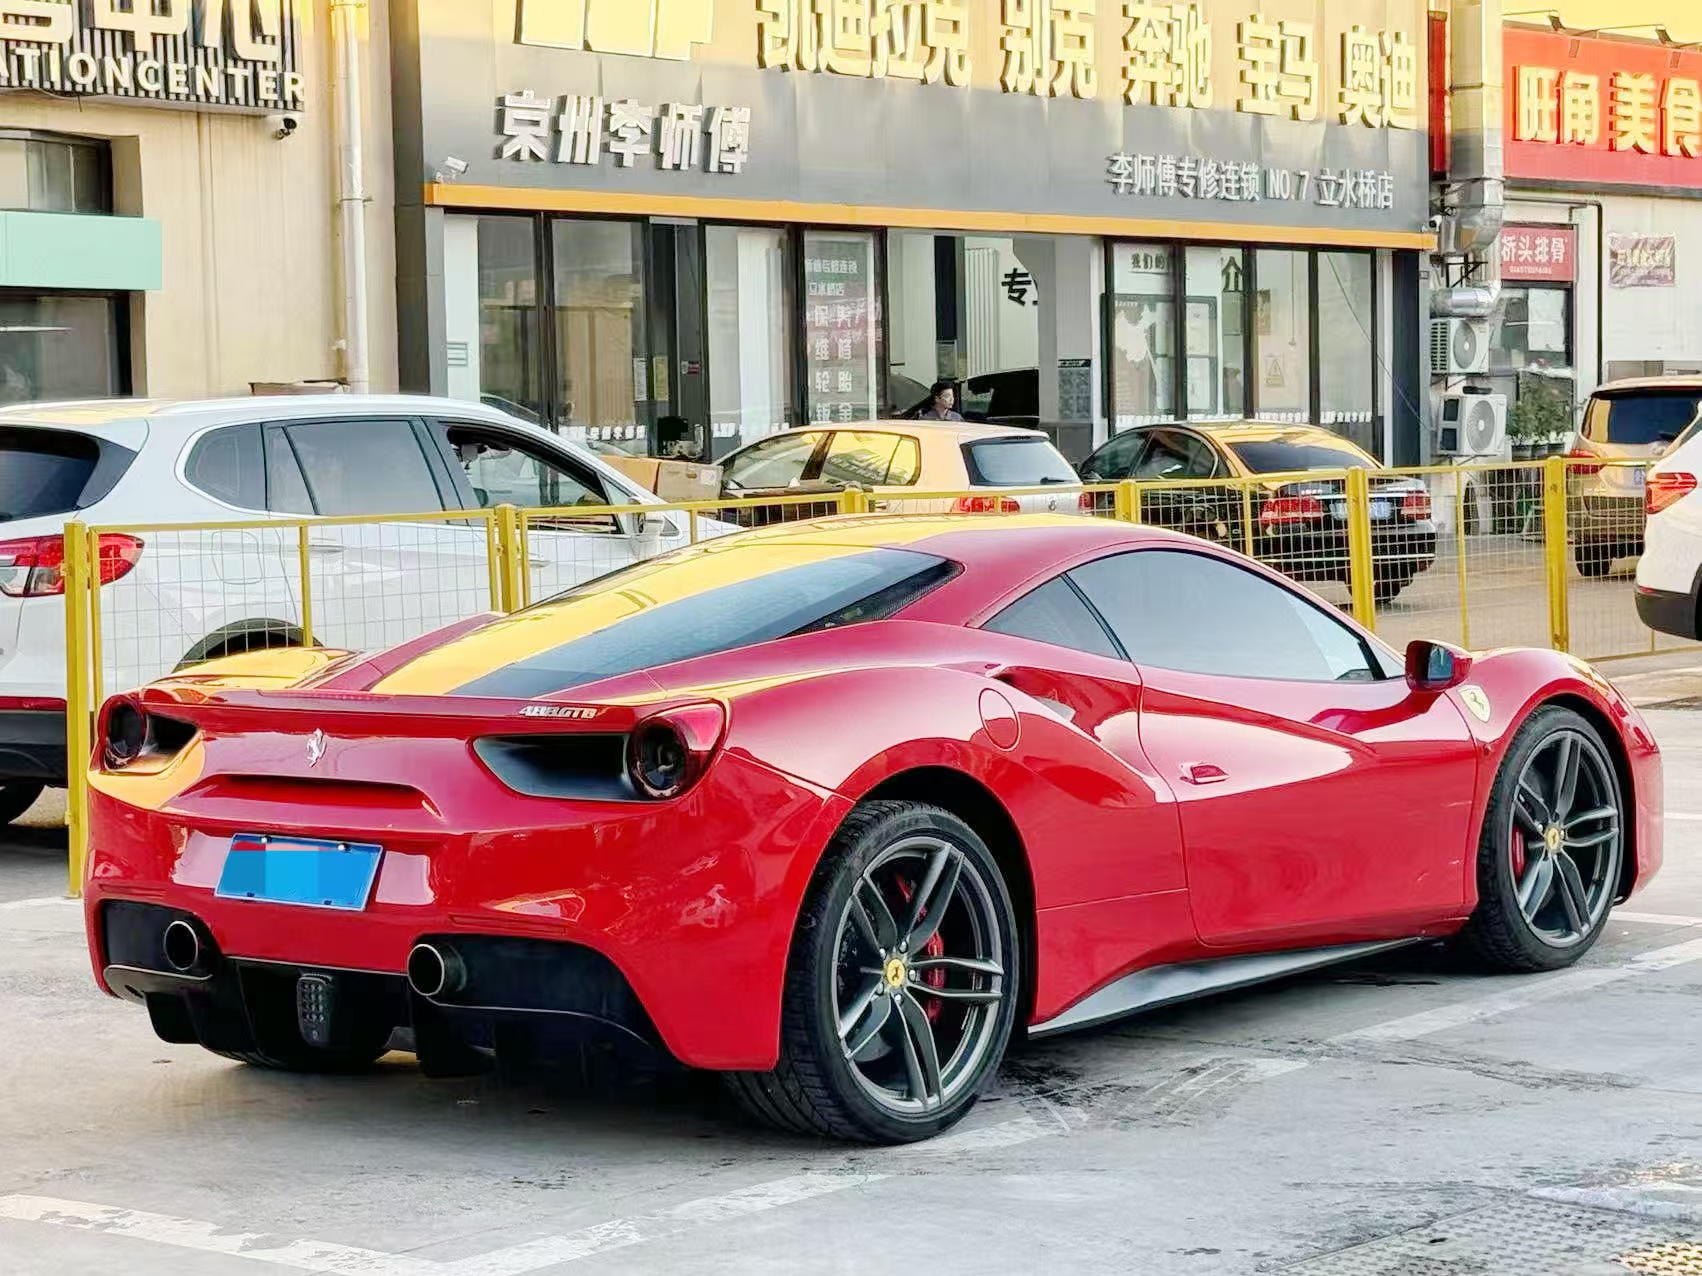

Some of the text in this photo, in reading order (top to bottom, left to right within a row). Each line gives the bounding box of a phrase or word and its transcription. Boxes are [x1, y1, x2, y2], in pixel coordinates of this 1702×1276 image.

[757, 0, 1417, 129] 凯迪拉克 别克 奔驰 宝马 奥迪
[1516, 64, 1702, 157] 旺角美食
[1109, 151, 1261, 201] 李师傅专修连锁
[1316, 168, 1394, 209] 立水桥店
